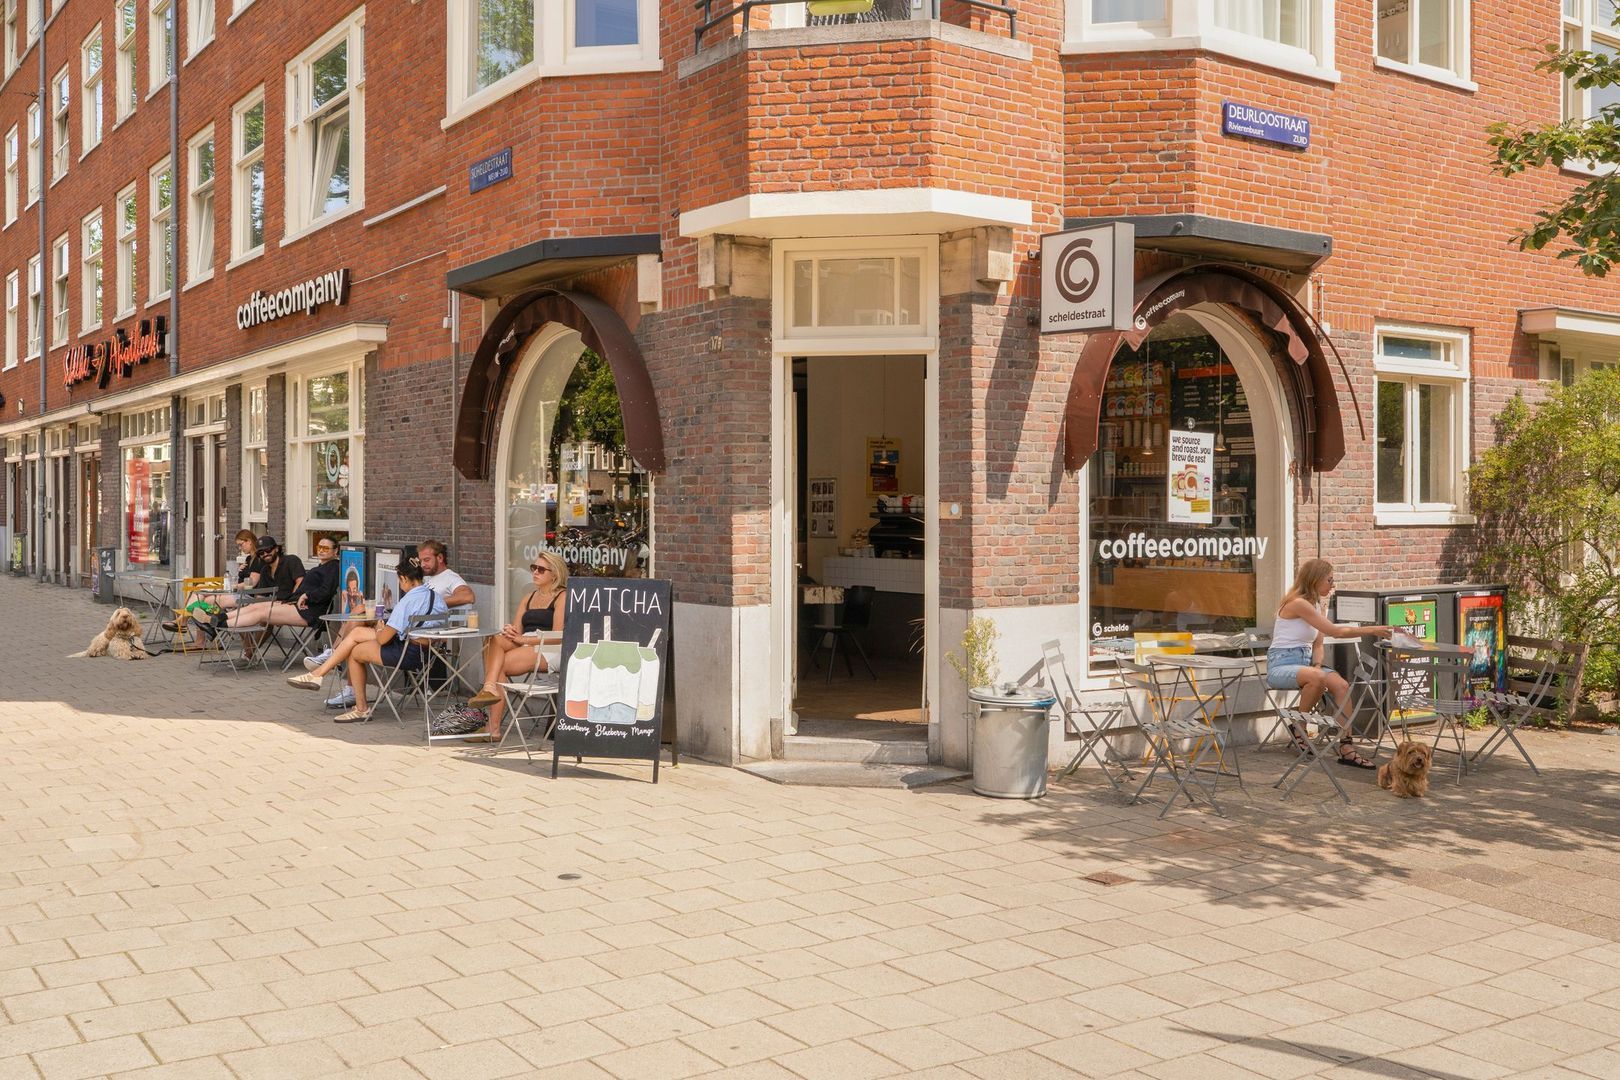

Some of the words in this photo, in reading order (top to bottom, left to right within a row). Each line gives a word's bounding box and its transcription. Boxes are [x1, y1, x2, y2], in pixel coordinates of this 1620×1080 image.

[1229, 105, 1308, 133] DEURLOOSTRAAT
[1228, 121, 1264, 136] Rivierenbuurt
[1292, 134, 1308, 144] ZUID
[237, 268, 344, 330] coffeecompany
[1048, 307, 1106, 323] scheldestraat
[1172, 436, 1181, 444] we
[1182, 436, 1201, 445] source
[1171, 444, 1183, 453] and
[1200, 447, 1212, 455] you
[1171, 452, 1186, 462] brew
[1187, 454, 1195, 463] de
[1195, 456, 1206, 464] rest
[1099, 532, 1269, 560] coffeecompany
[569, 587, 662, 615] MATCHA
[557, 718, 590, 736] Strawberry
[595, 723, 628, 739] Blueberry
[631, 726, 655, 737] Mango
